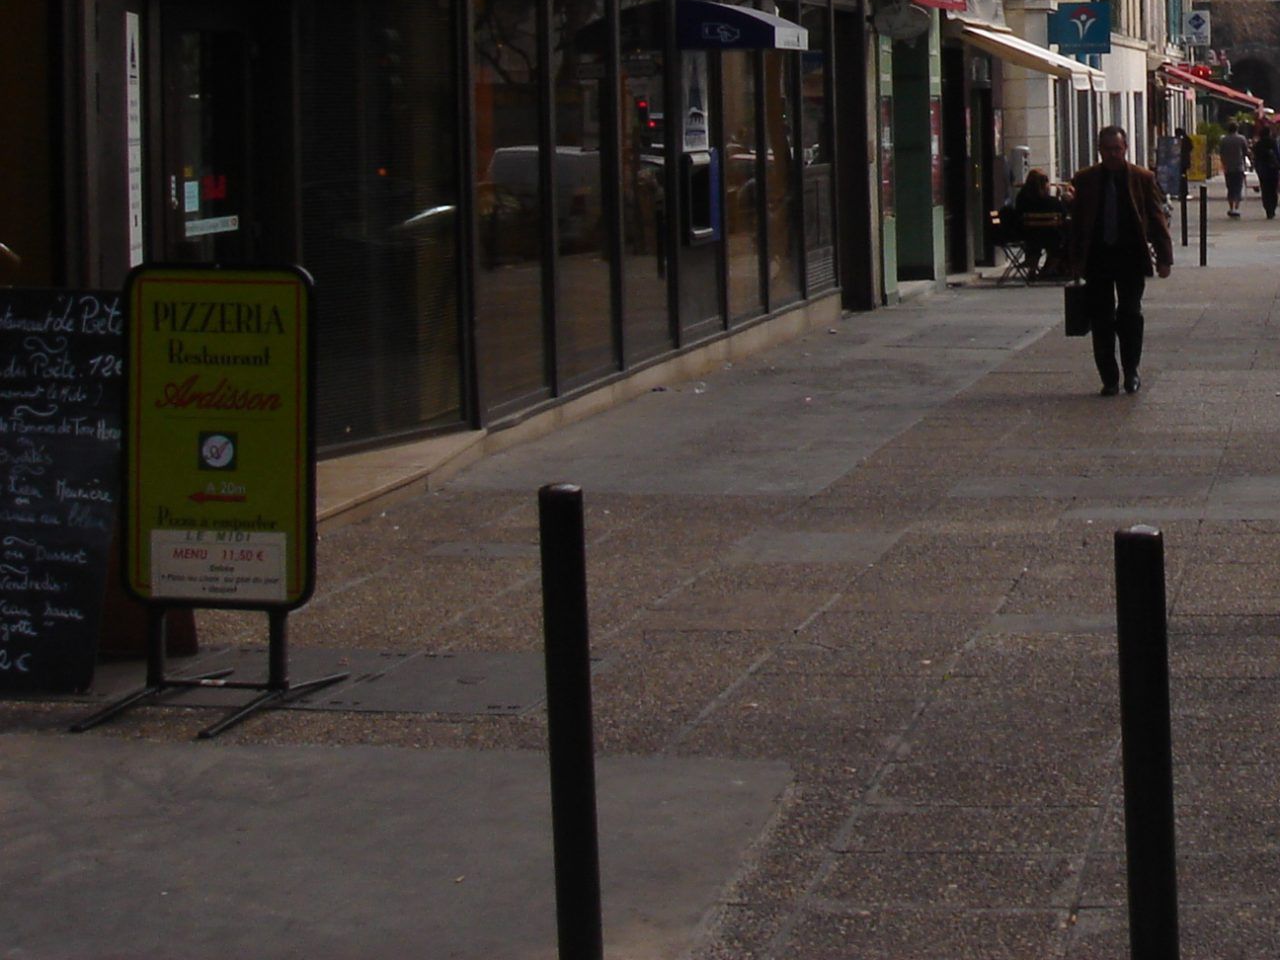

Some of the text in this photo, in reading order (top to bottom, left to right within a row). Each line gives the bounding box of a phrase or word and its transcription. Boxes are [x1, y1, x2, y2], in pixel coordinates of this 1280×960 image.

[153, 301, 286, 335] PIZZERIA
[168, 337, 272, 366] Restaurant
[154, 374, 283, 411] Ardisson
[157, 504, 197, 528] Pizza
[215, 531, 251, 542] MIDI
[172, 548, 209, 560] MENU
